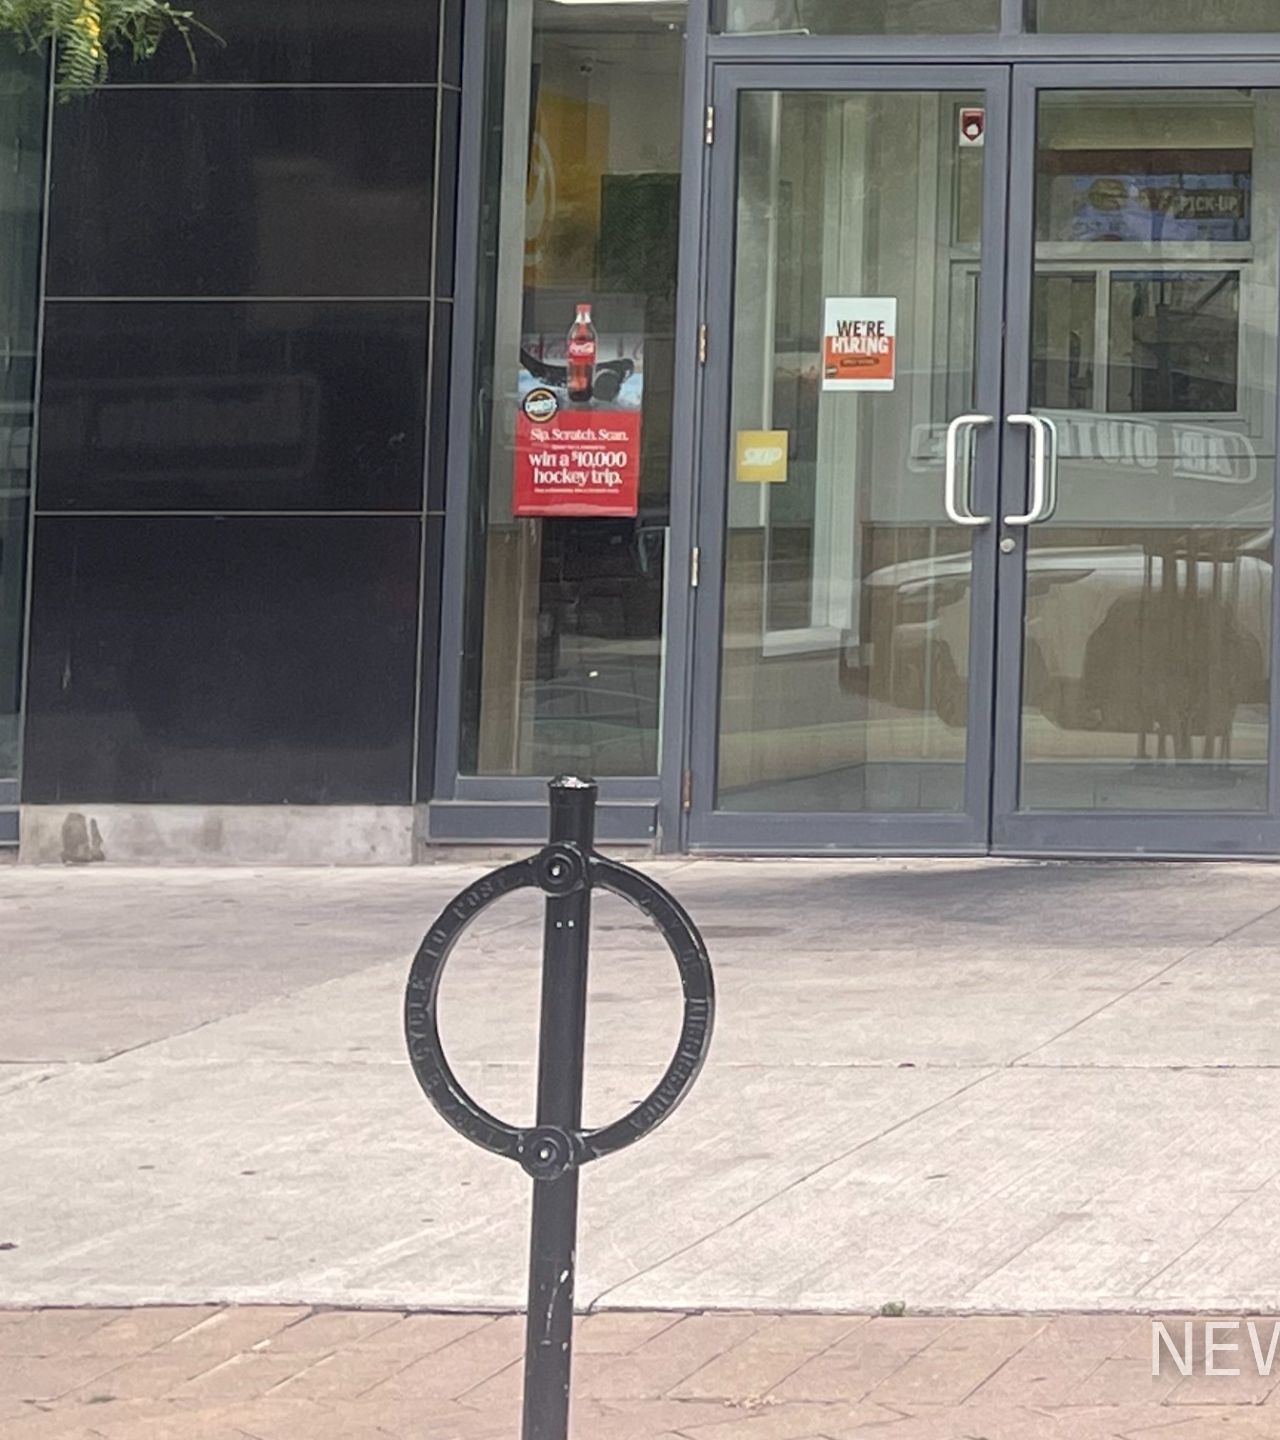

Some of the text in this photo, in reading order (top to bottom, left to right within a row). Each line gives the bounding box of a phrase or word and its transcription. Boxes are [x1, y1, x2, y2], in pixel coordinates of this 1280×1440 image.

[836, 320, 886, 338] WE'RE
[830, 337, 889, 355] HIRING
[528, 452, 557, 468] win
[559, 455, 570, 468] a
[533, 467, 623, 486] hockey trip.
